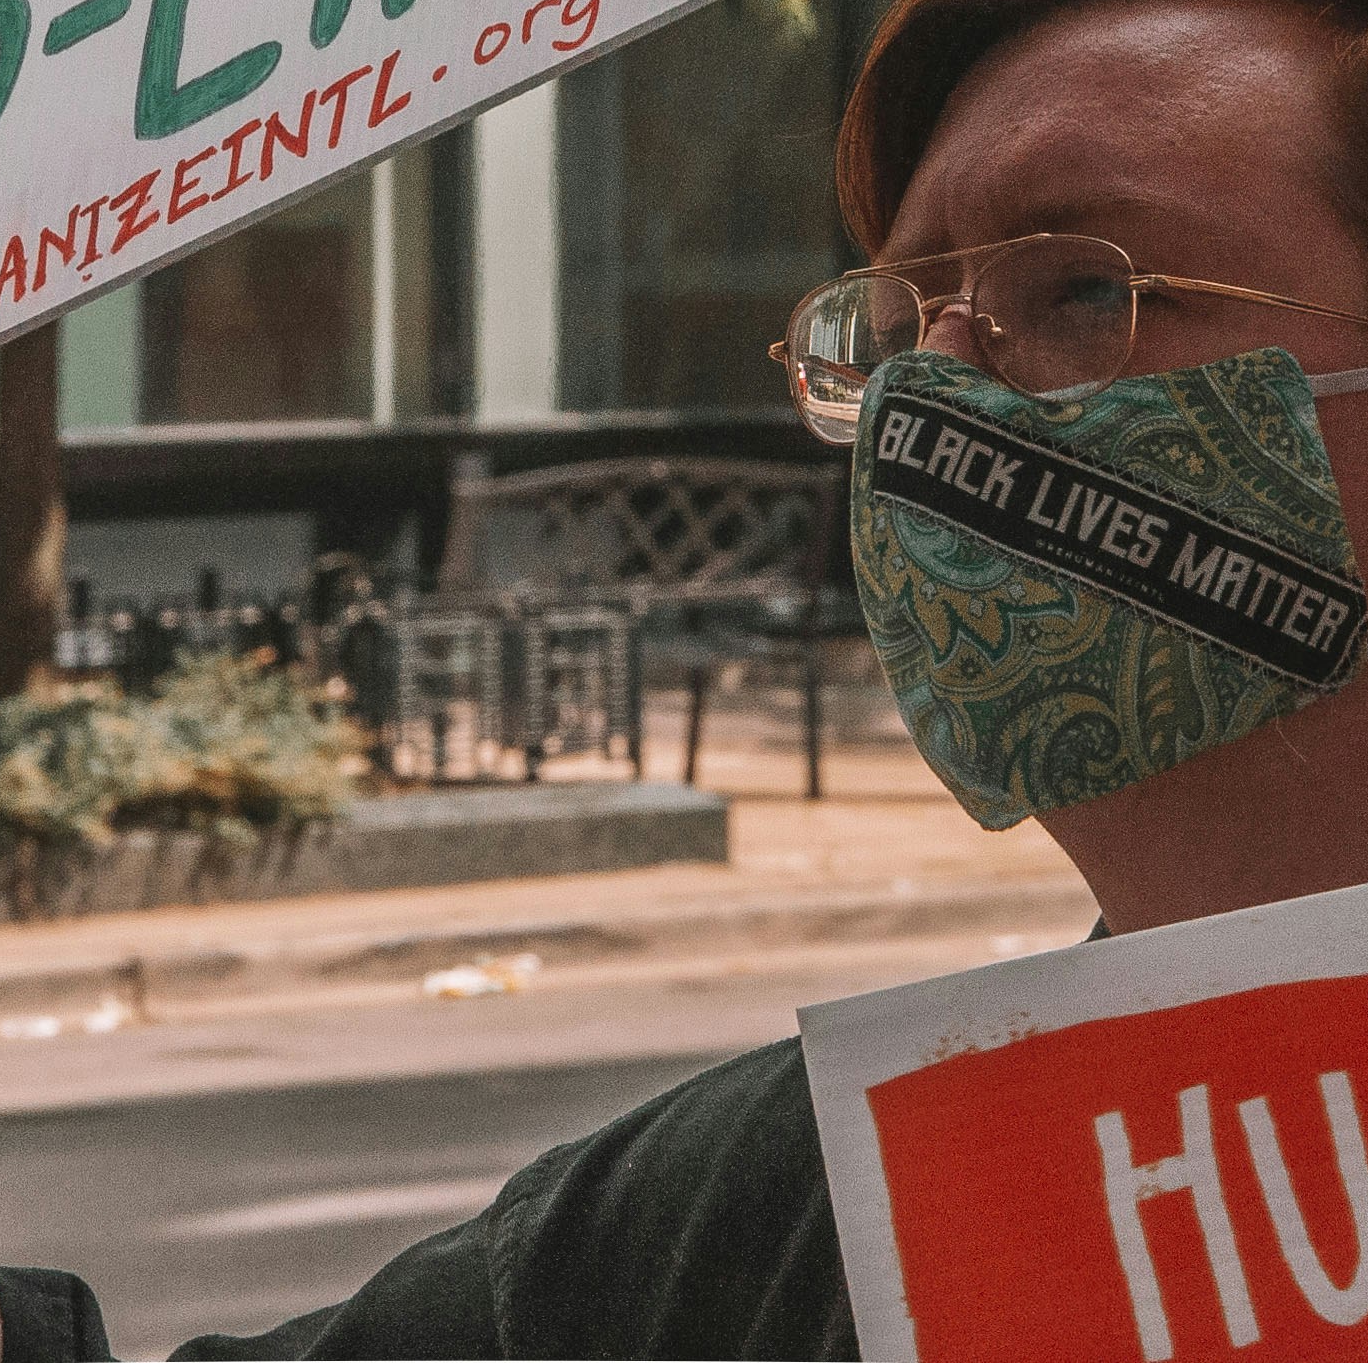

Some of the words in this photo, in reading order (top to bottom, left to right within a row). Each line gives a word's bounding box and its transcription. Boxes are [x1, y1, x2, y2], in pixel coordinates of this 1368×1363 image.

[877, 409, 1028, 510] BLACK
[1027, 469, 1170, 567] LIVES
[1168, 531, 1353, 654] MATTER
